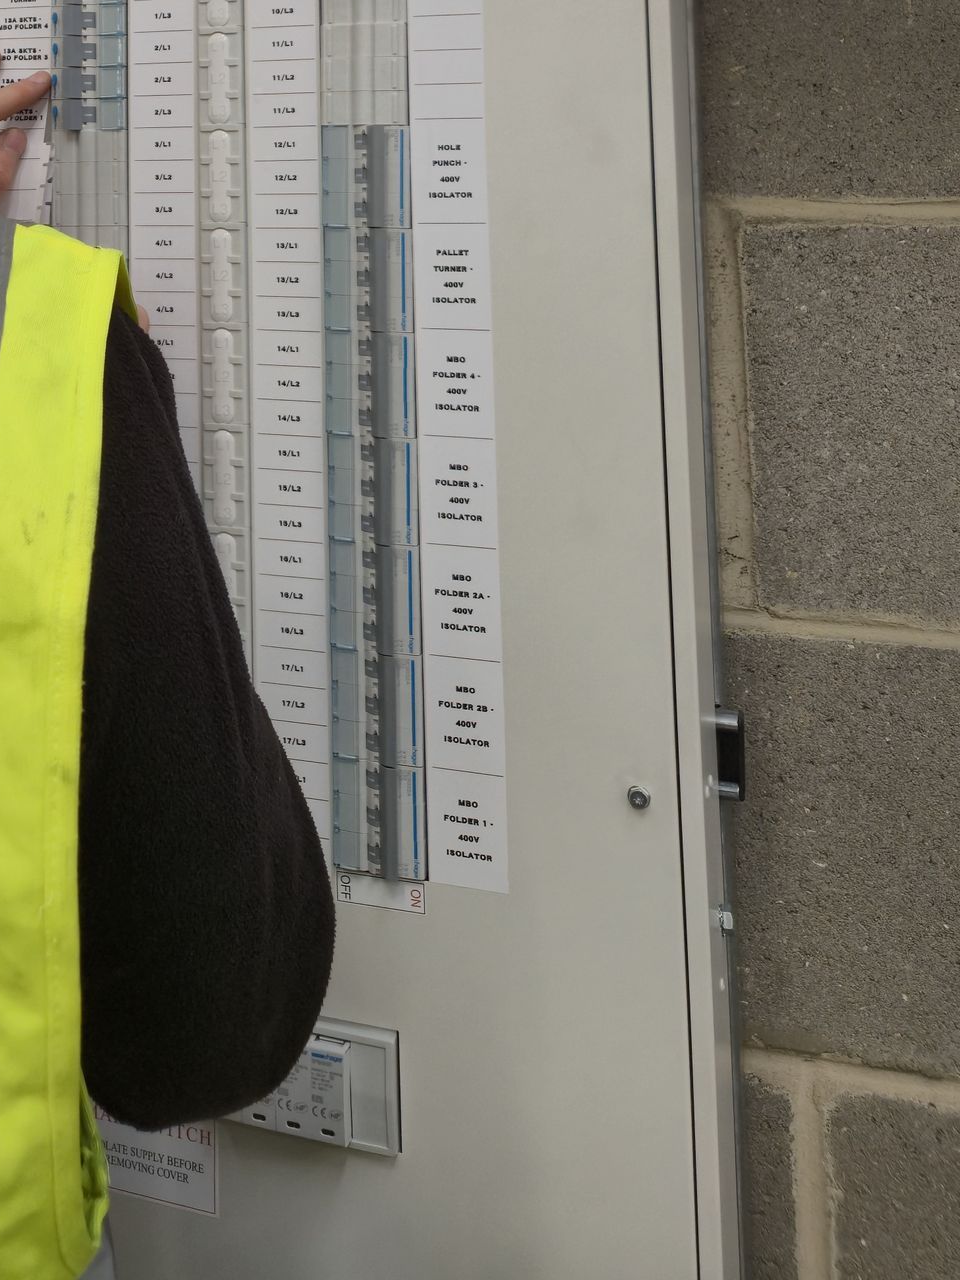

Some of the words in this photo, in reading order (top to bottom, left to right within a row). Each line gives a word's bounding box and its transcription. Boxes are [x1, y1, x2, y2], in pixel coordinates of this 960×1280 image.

[435, 403, 479, 412] ISOLATOR
[435, 479, 470, 488] FOLDER
[278, 484, 301, 493] 15/L2
[438, 512, 483, 522] ISOLATOR
[279, 555, 302, 563] 16/L1
[452, 574, 472, 582] MBO
[280, 591, 303, 600] 16/L2
[434, 588, 470, 598] FOLDER
[281, 627, 304, 635] 16/L3
[441, 622, 486, 634] ISOLATOR
[281, 664, 304, 672] 17/L1
[456, 685, 476, 694] MBO
[282, 700, 305, 709] 17/L2
[438, 700, 474, 711] FOLDER
[455, 720, 477, 729] 400V
[282, 737, 306, 746] 17/L3
[444, 735, 490, 748] ISOLATOR
[458, 799, 478, 808] MBO
[443, 814, 479, 826] FOLDER
[458, 834, 480, 843] 400V
[446, 848, 493, 862] ISOLATOR
[340, 874, 351, 901] OFF
[410, 889, 422, 909] ON
[129, 1146, 166, 1164] SUPPLY
[167, 1155, 205, 1174] BEFORE
[156, 1166, 190, 1184] COVER
